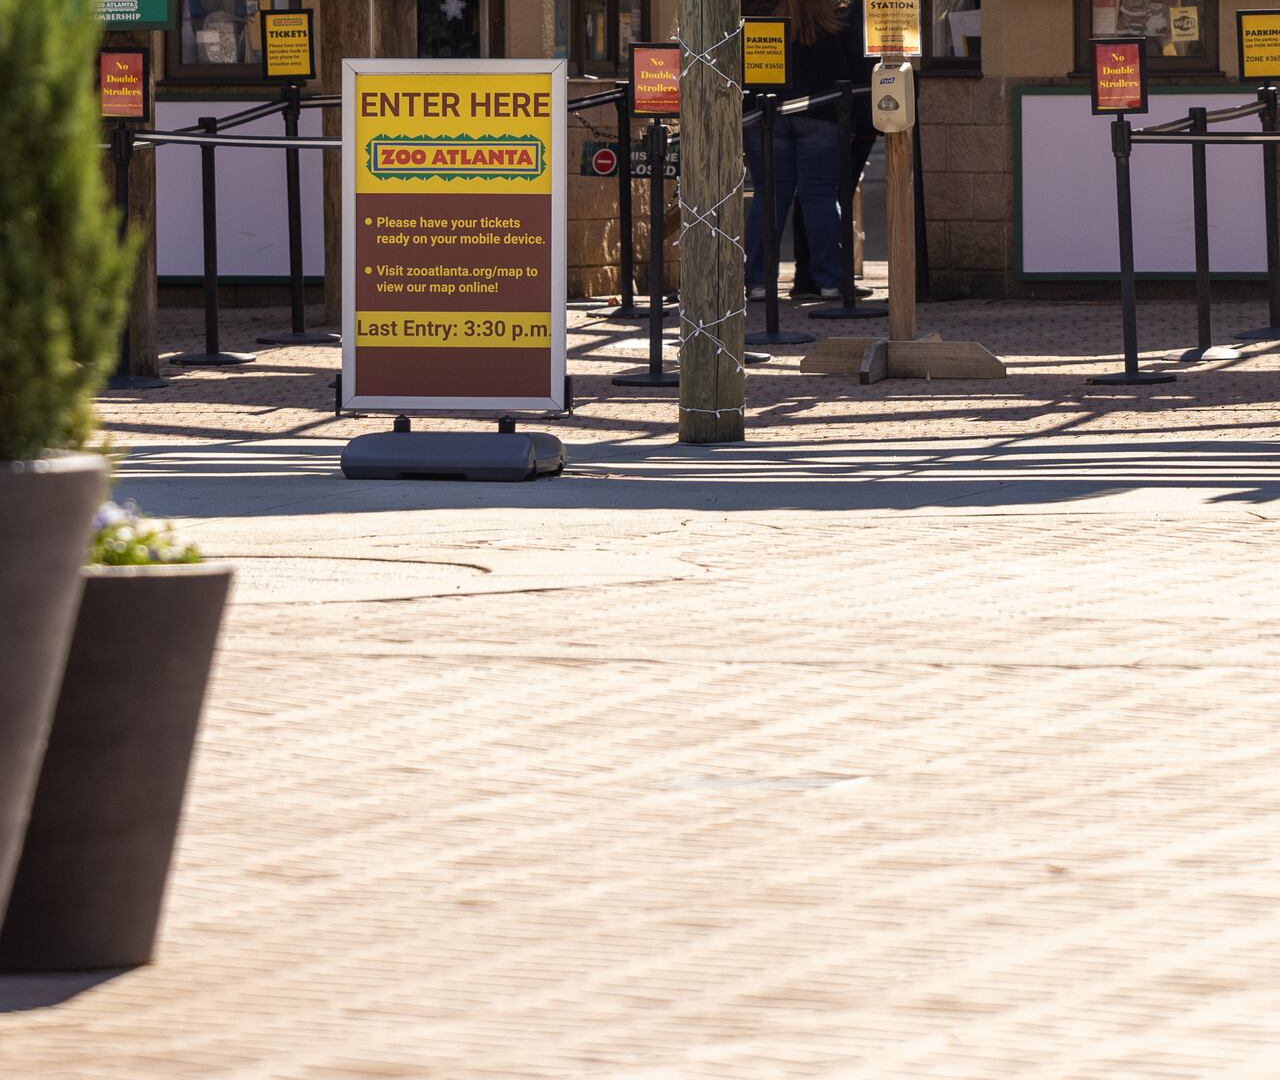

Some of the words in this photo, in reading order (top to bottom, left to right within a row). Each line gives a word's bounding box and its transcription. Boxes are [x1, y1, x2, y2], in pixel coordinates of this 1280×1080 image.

[269, 30, 307, 38] TICKETS
[650, 58, 664, 66] No
[1112, 53, 1125, 62] No
[115, 62, 129, 70] No
[1103, 66, 1135, 75] Double
[106, 74, 138, 83] Double
[641, 71, 673, 79] Double
[637, 84, 678, 92] Strollers
[1100, 80, 1138, 88] Strollers
[104, 88, 141, 96] Strollers
[361, 92, 460, 117] ENTER
[470, 92, 551, 117] HERE
[381, 149, 426, 164] ZOO
[432, 149, 533, 165] ATLANTA
[376, 217, 417, 228] Please
[420, 217, 448, 228] have
[451, 219, 478, 231] your
[480, 217, 520, 228] tickets
[376, 233, 409, 246] ready
[412, 236, 428, 244] on
[430, 235, 457, 247] your
[460, 233, 500, 244] mobile
[503, 233, 546, 244] device.
[376, 266, 403, 276] Visit
[406, 265, 523, 279] zooatlanta.org/map
[526, 267, 538, 277] to
[376, 282, 403, 292] view
[406, 284, 425, 293] our
[429, 284, 455, 296] map
[458, 282, 498, 293] online!
[357, 320, 397, 337] Last
[404, 320, 458, 340] Entry:
[464, 320, 506, 337] 3:30
[511, 323, 552, 341] p.m.
